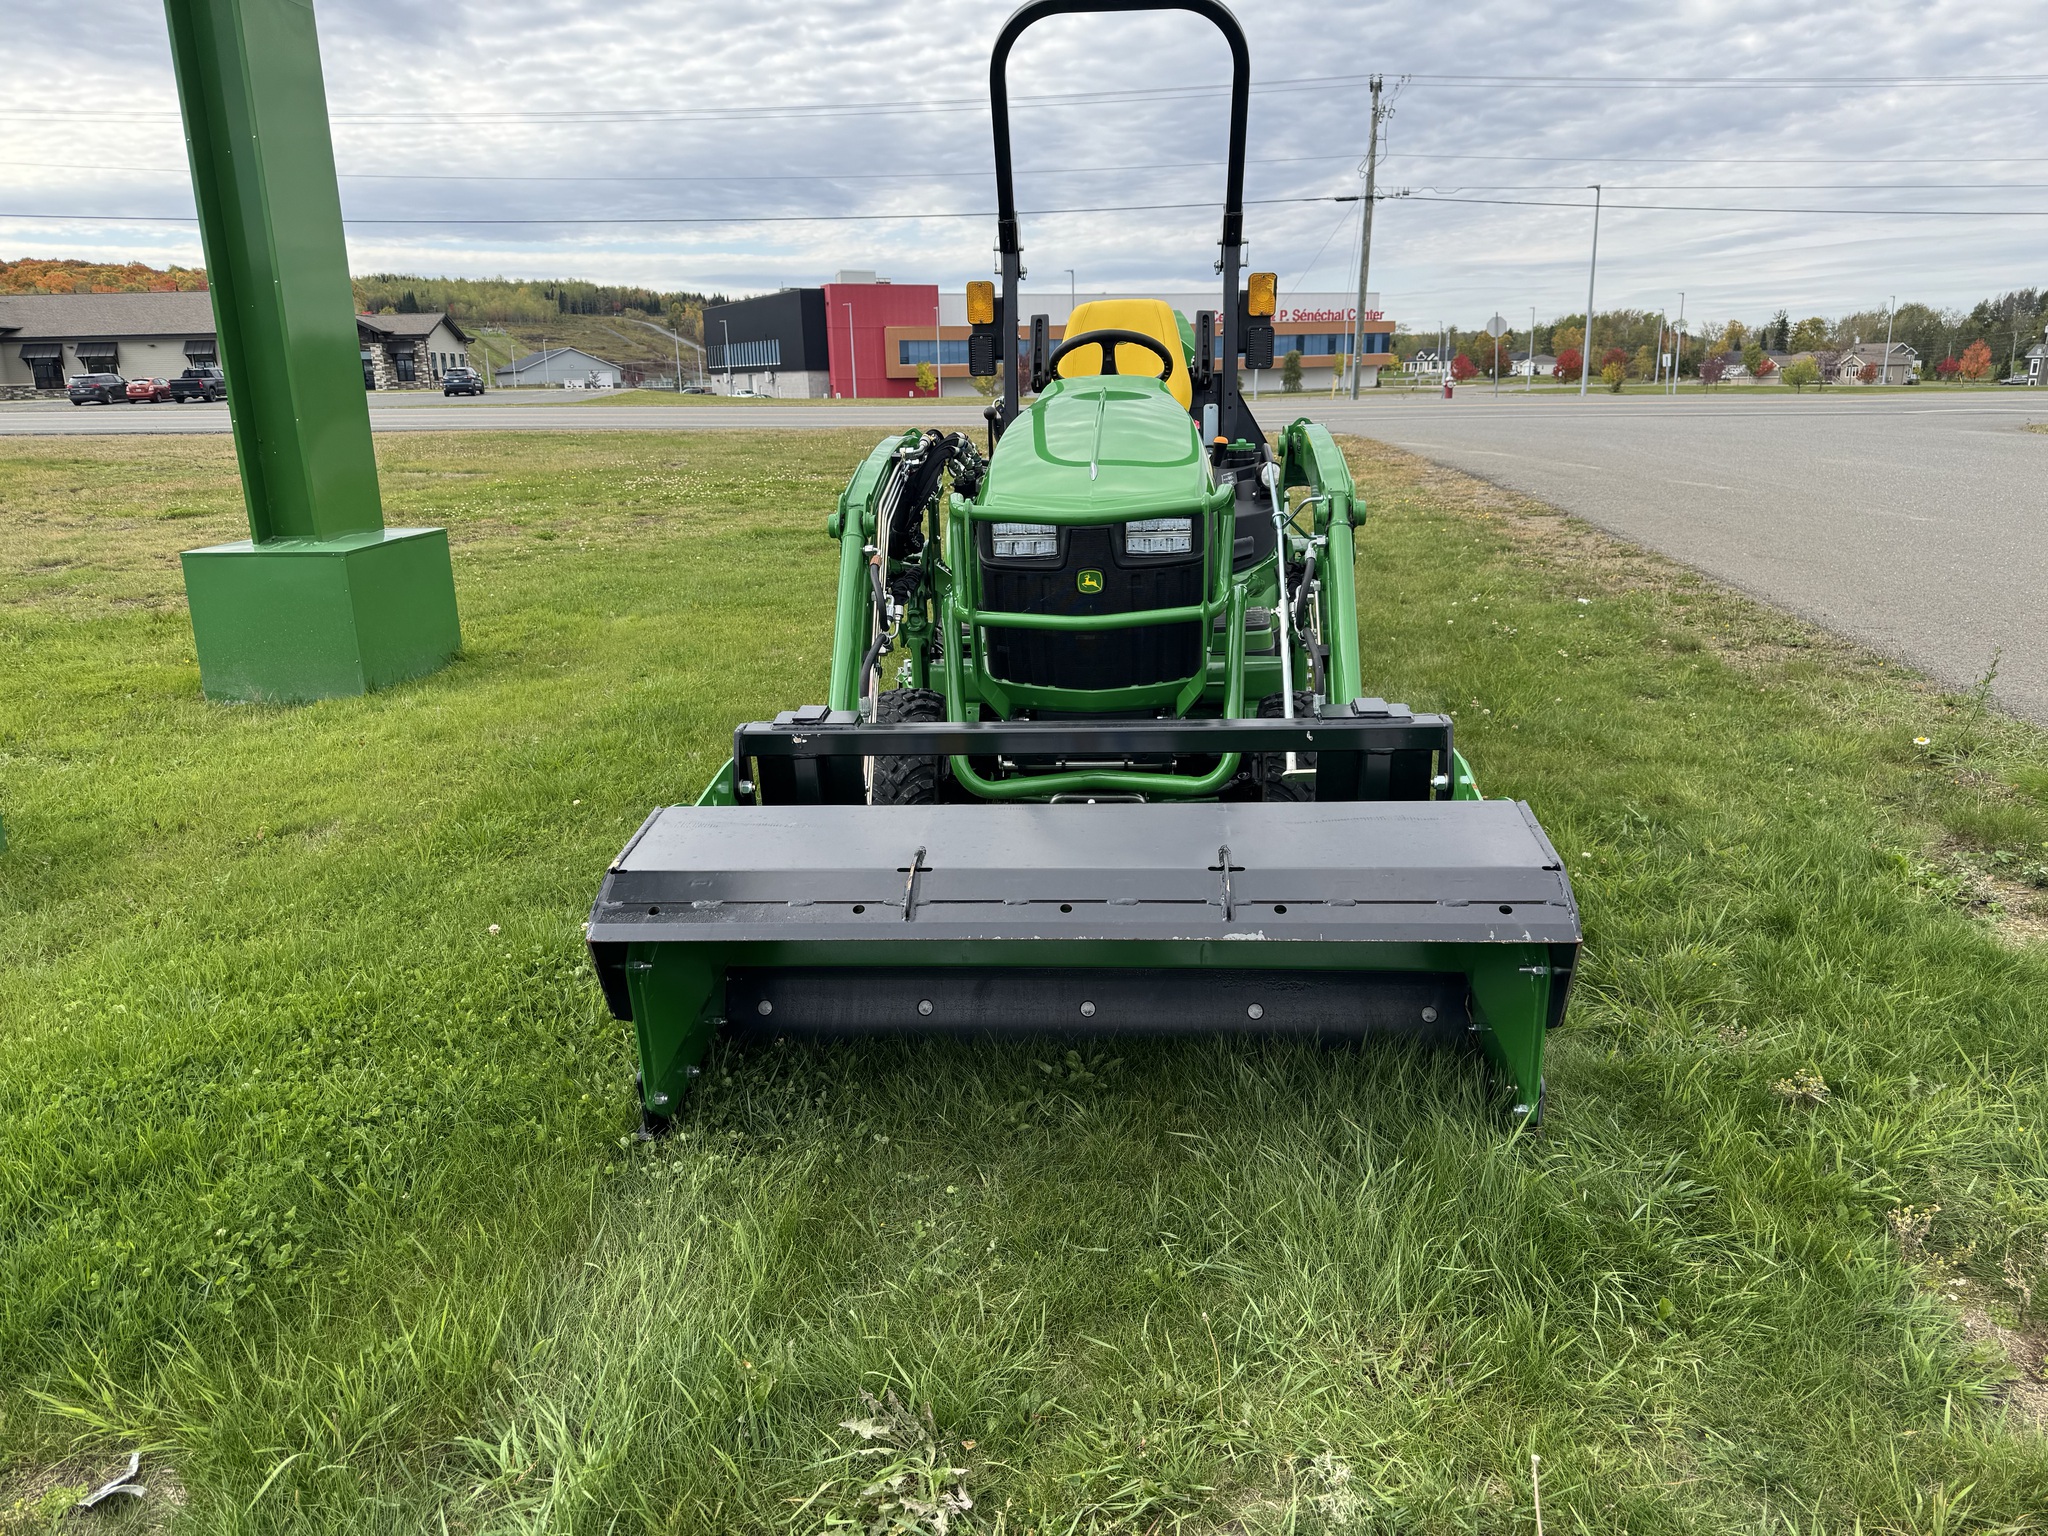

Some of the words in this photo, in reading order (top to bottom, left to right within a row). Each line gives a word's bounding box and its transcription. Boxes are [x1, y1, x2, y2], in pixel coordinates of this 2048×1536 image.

[1280, 309, 1289, 321] P.
[1292, 308, 1345, 321] Sénéchal
[1347, 308, 1384, 321] Cnter
